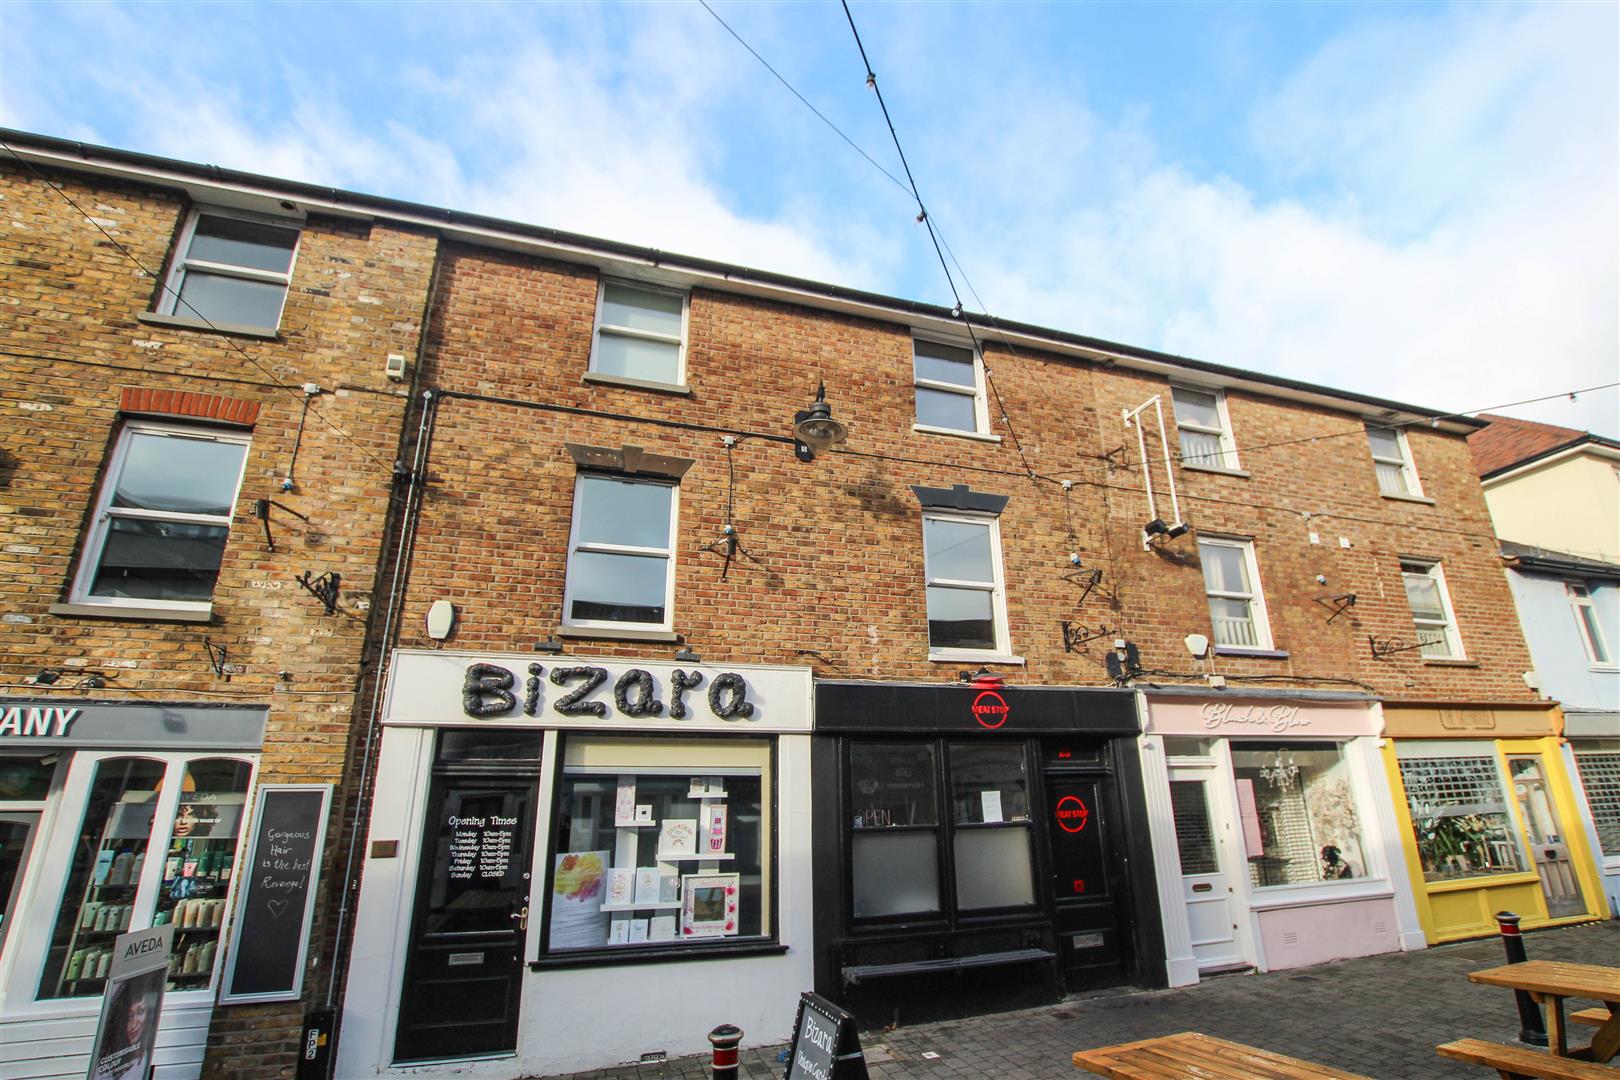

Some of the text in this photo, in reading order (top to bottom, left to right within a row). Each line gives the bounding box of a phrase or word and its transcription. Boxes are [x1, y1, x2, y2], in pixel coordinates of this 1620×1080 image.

[462, 662, 755, 720] Bizara
[972, 705, 1009, 714] MEAT STOP
[1055, 810, 1089, 818] MEAT STOP
[448, 815, 518, 829] Opening Times
[267, 828, 311, 844] Gorgeous
[455, 830, 478, 838] Monday
[454, 837, 478, 845] Tuesday
[270, 844, 294, 856] Hair
[262, 857, 311, 870] is the best
[448, 864, 476, 872] Saturday
[450, 870, 505, 879] Sunday CLOSED
[125, 936, 164, 958] AVEDA
[804, 1015, 832, 1054] Bizara
